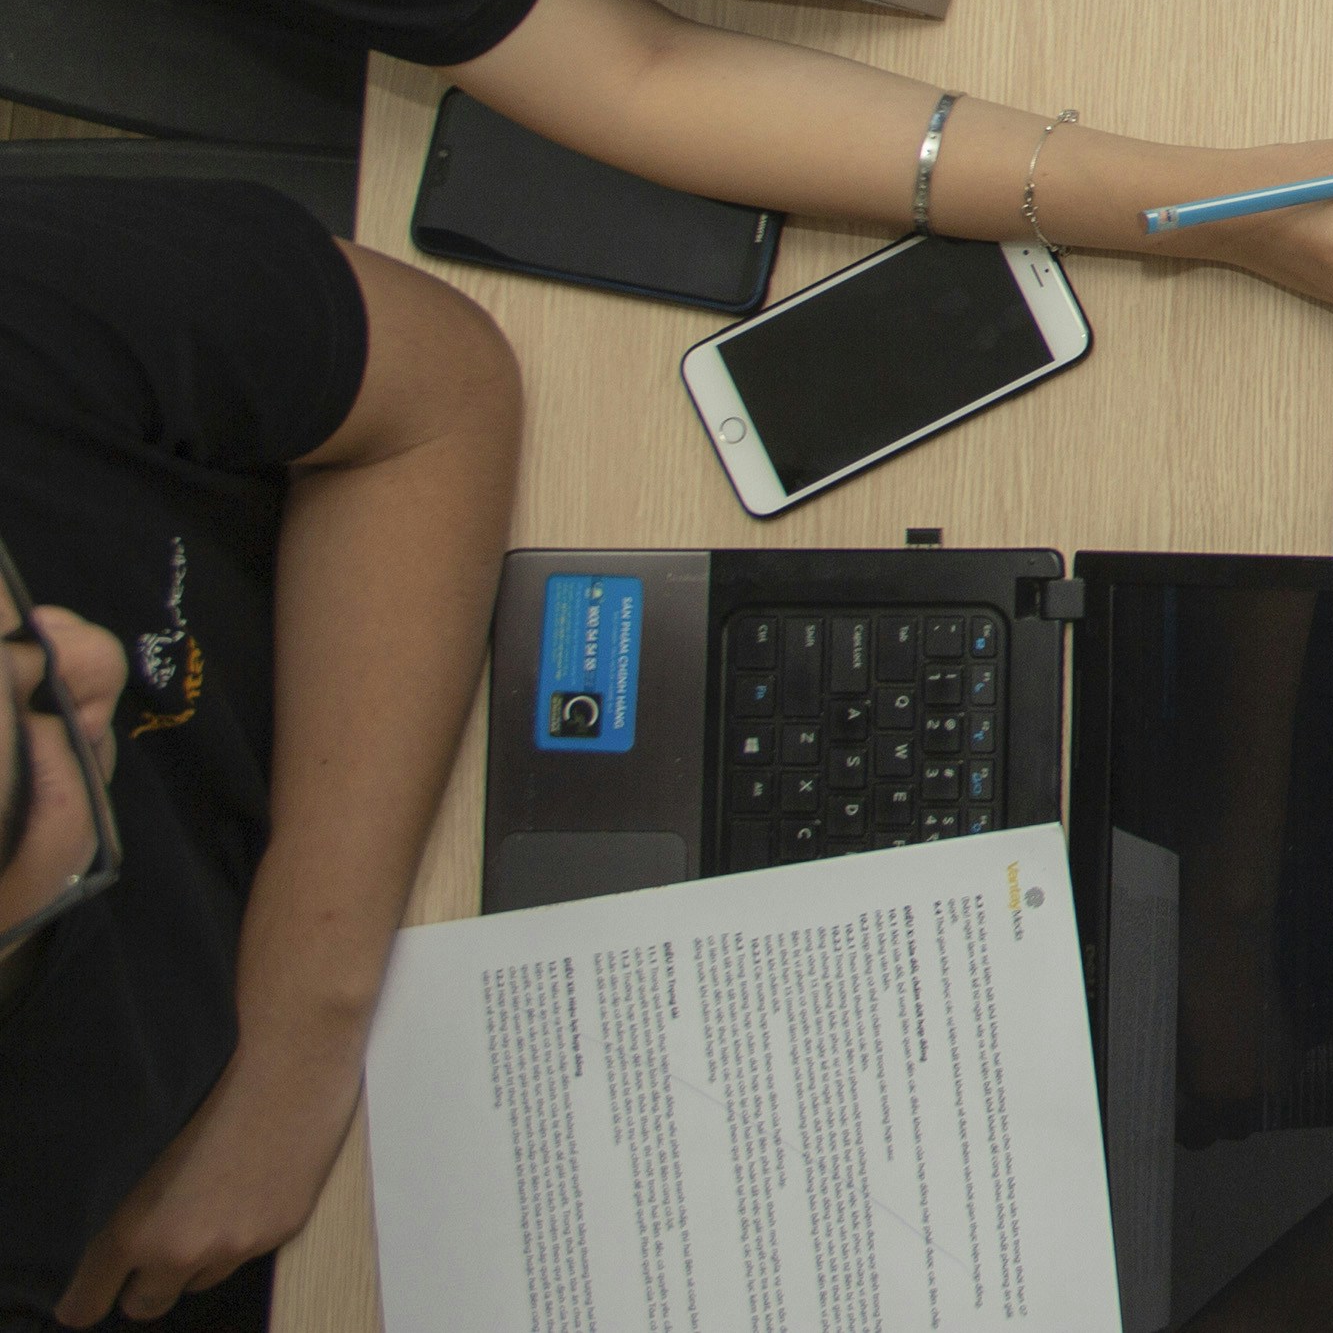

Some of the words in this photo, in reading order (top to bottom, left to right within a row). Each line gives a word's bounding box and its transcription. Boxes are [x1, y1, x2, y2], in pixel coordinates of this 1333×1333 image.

[893, 694, 909, 708] Q
[894, 743, 908, 760] W
[892, 791, 906, 801] E
